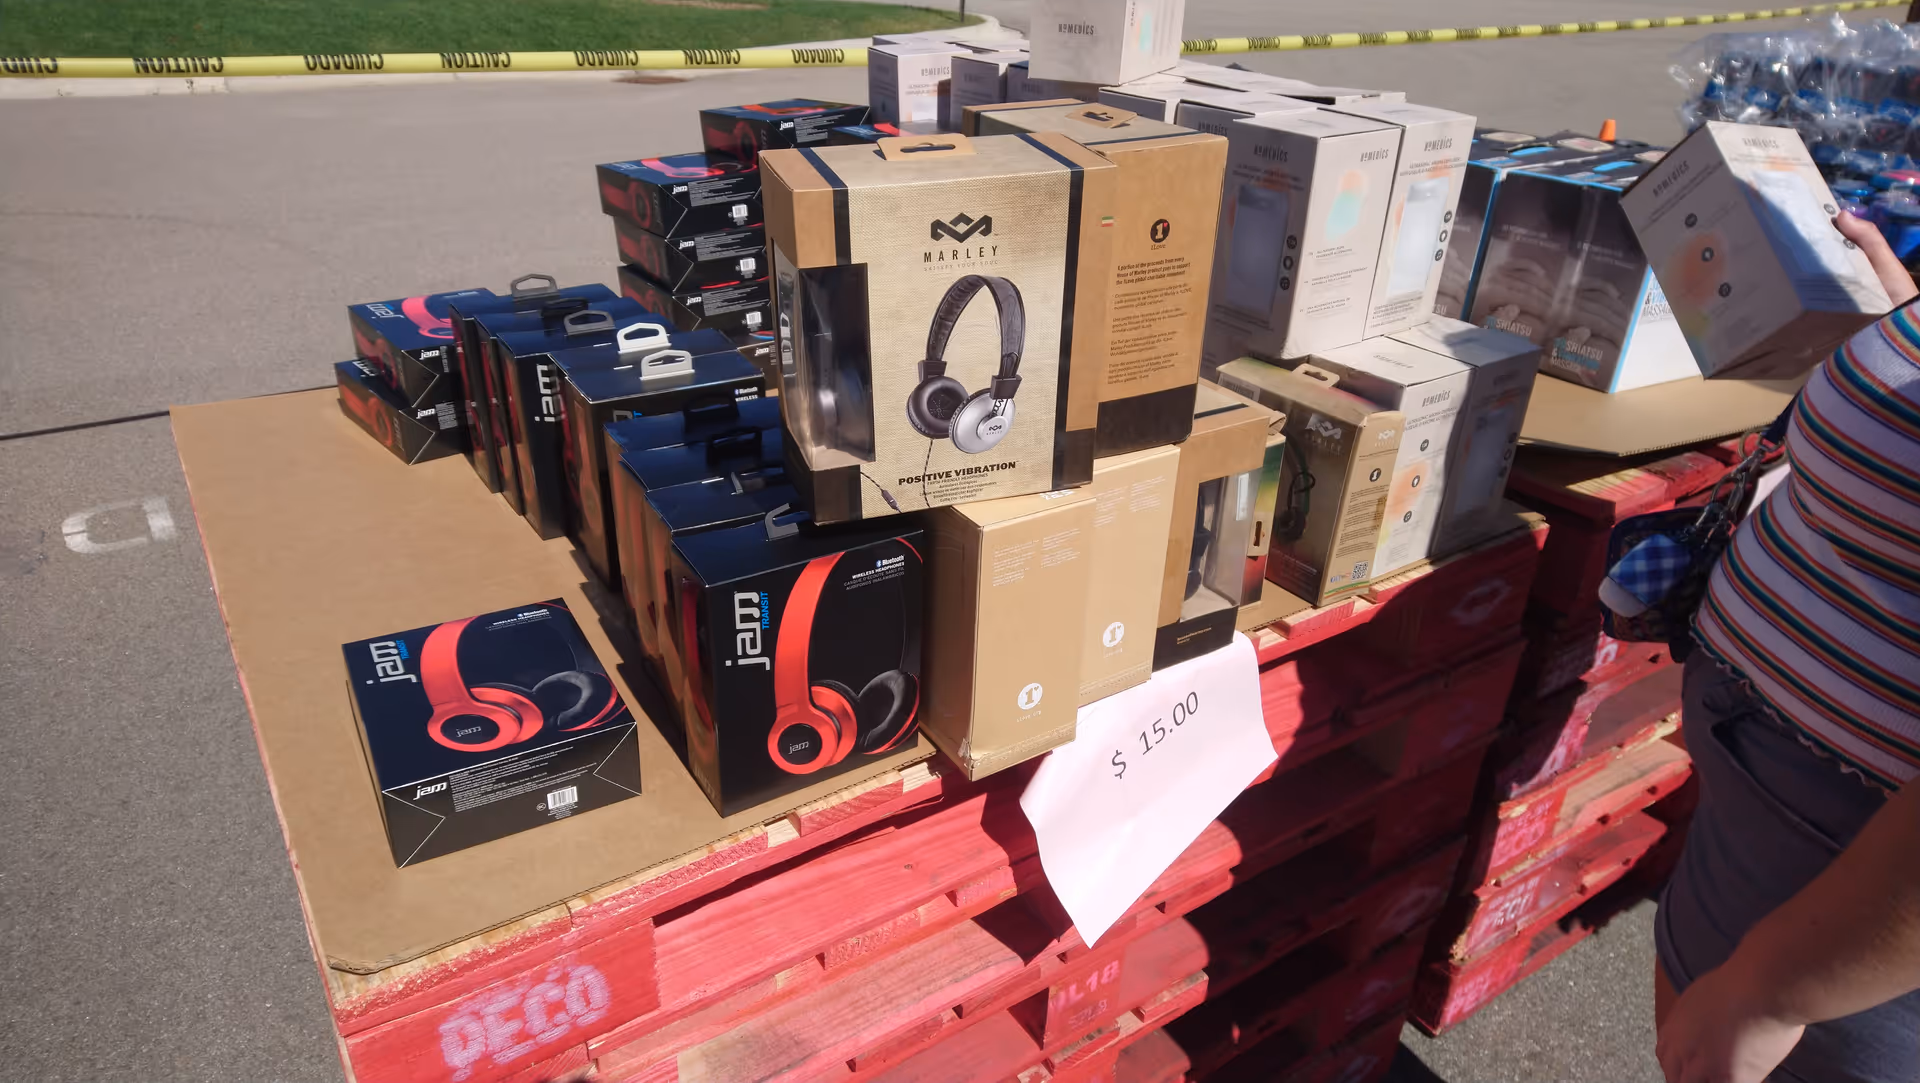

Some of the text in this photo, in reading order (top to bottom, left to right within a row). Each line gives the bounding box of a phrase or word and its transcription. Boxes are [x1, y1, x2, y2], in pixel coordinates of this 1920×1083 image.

[132, 57, 224, 74] CAUTION
[302, 54, 384, 71] CUIDADO
[439, 51, 511, 69] CAUTION
[681, 49, 741, 65] CAUTION
[779, 120, 794, 131] jam
[672, 184, 688, 195] jam
[678, 239, 695, 250] jam
[923, 245, 998, 263] MARLEY
[686, 296, 702, 306] jam
[419, 349, 440, 360] jam
[754, 346, 769, 357] jam
[1566, 339, 1604, 361] SHIATSU
[416, 407, 436, 419] jam
[898, 461, 1017, 486] POSITIVE VIBRATION
[882, 554, 905, 566] Bluetooth
[852, 561, 905, 580] WIRELESS HEADPHONES
[759, 591, 770, 630] TRANSIT
[725, 591, 771, 671] jam
[366, 640, 417, 684] jam
[456, 725, 482, 738] jam
[1111, 691, 1199, 780] $ 15.00
[788, 740, 809, 755] jam
[413, 781, 448, 801] jam
